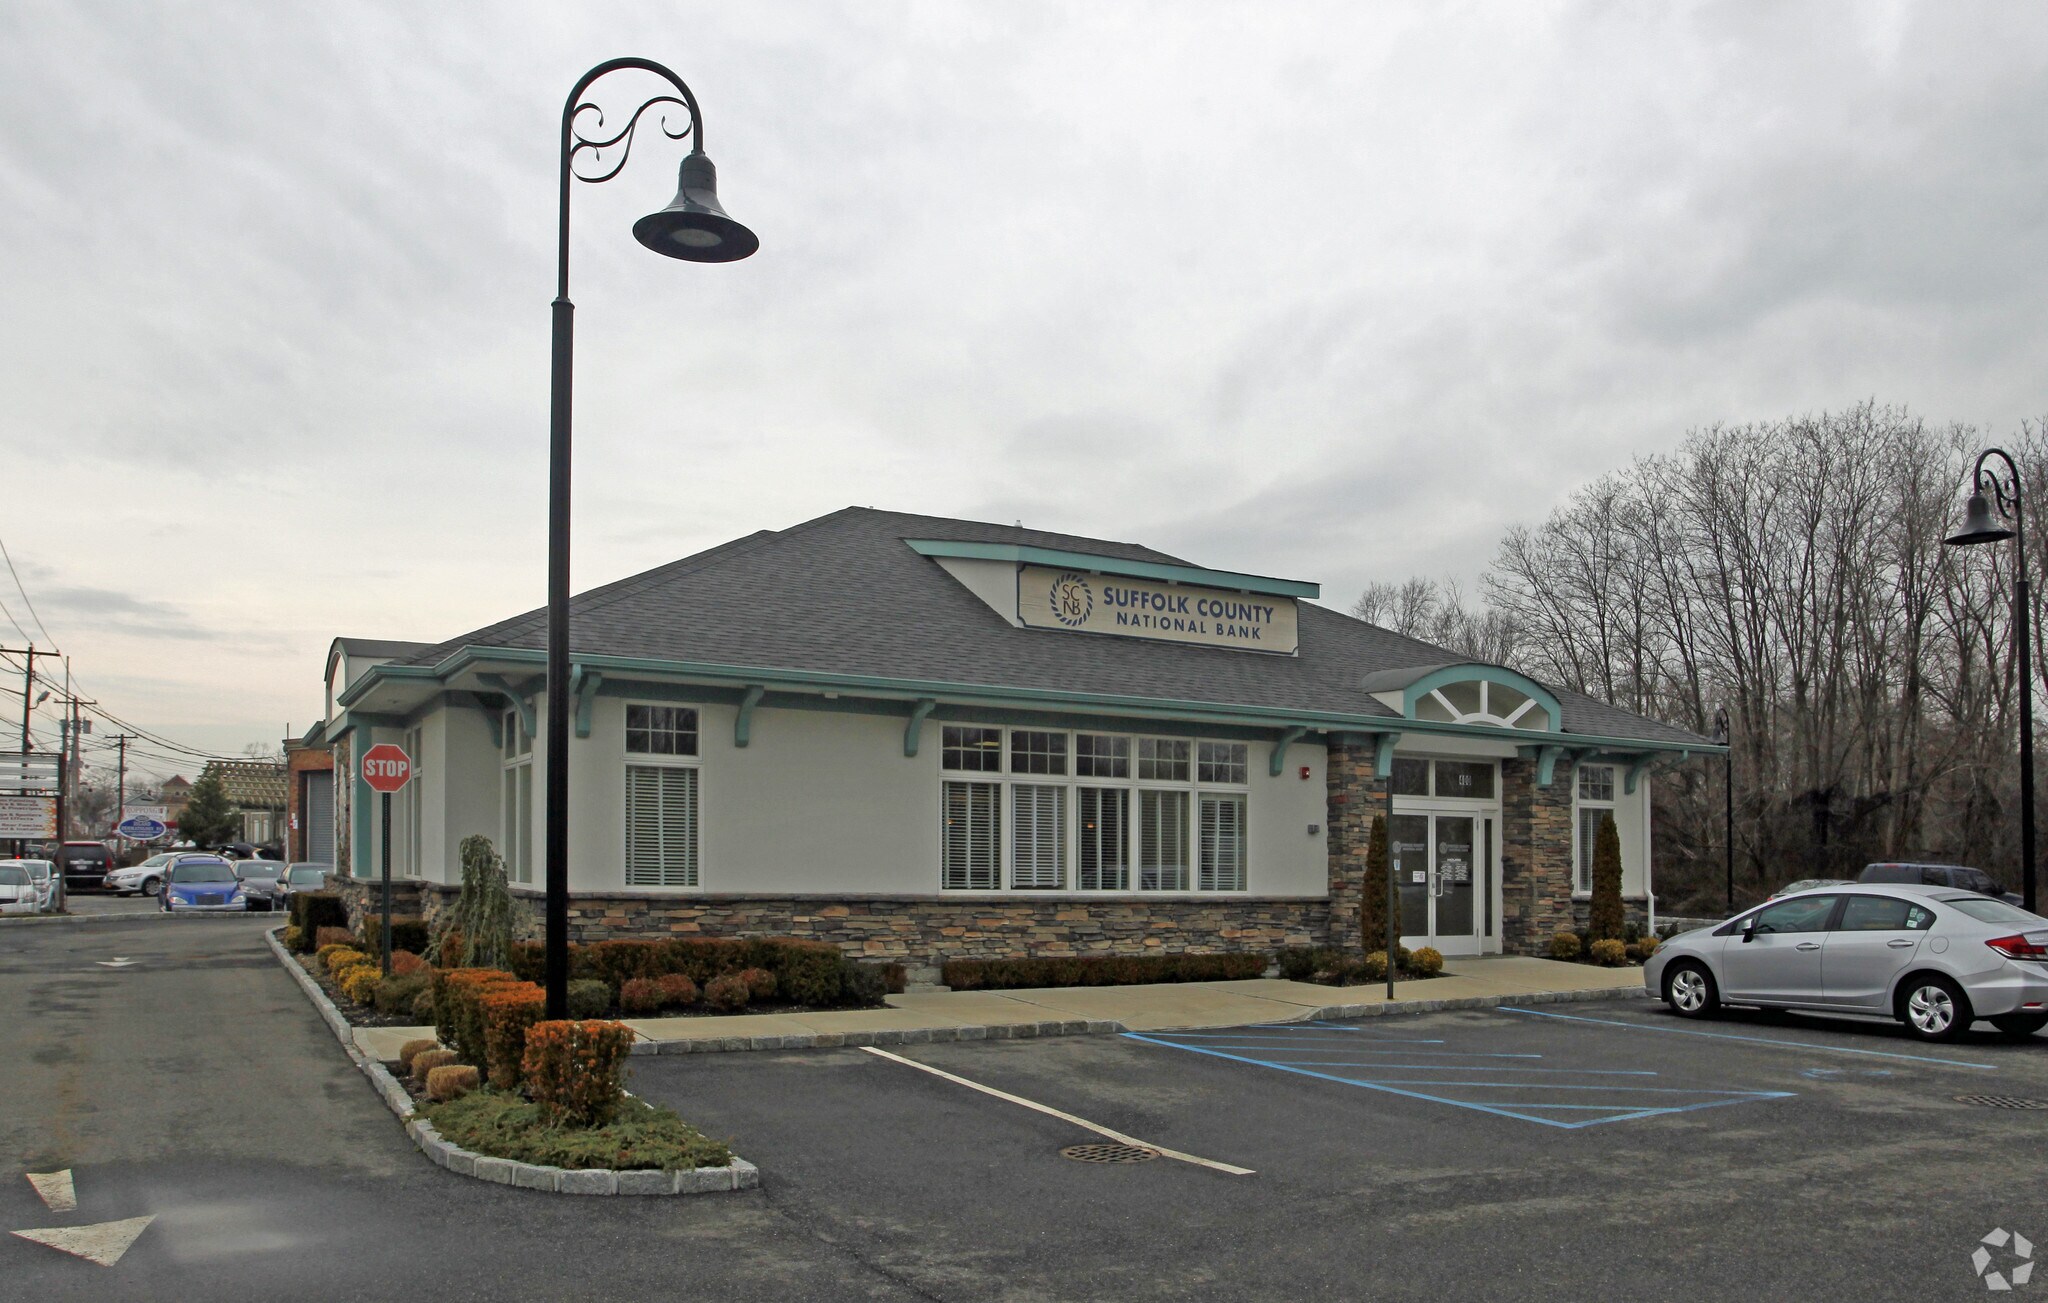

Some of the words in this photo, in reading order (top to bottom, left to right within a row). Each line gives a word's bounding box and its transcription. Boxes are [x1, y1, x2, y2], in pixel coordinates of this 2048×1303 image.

[1062, 584, 1080, 601] SC
[1103, 586, 1190, 614] SUFFOLK
[1197, 598, 1274, 624] COUNTY
[1116, 611, 1207, 634] NATIONAL
[1216, 622, 1261, 640] BANK
[365, 759, 408, 778] STOP
